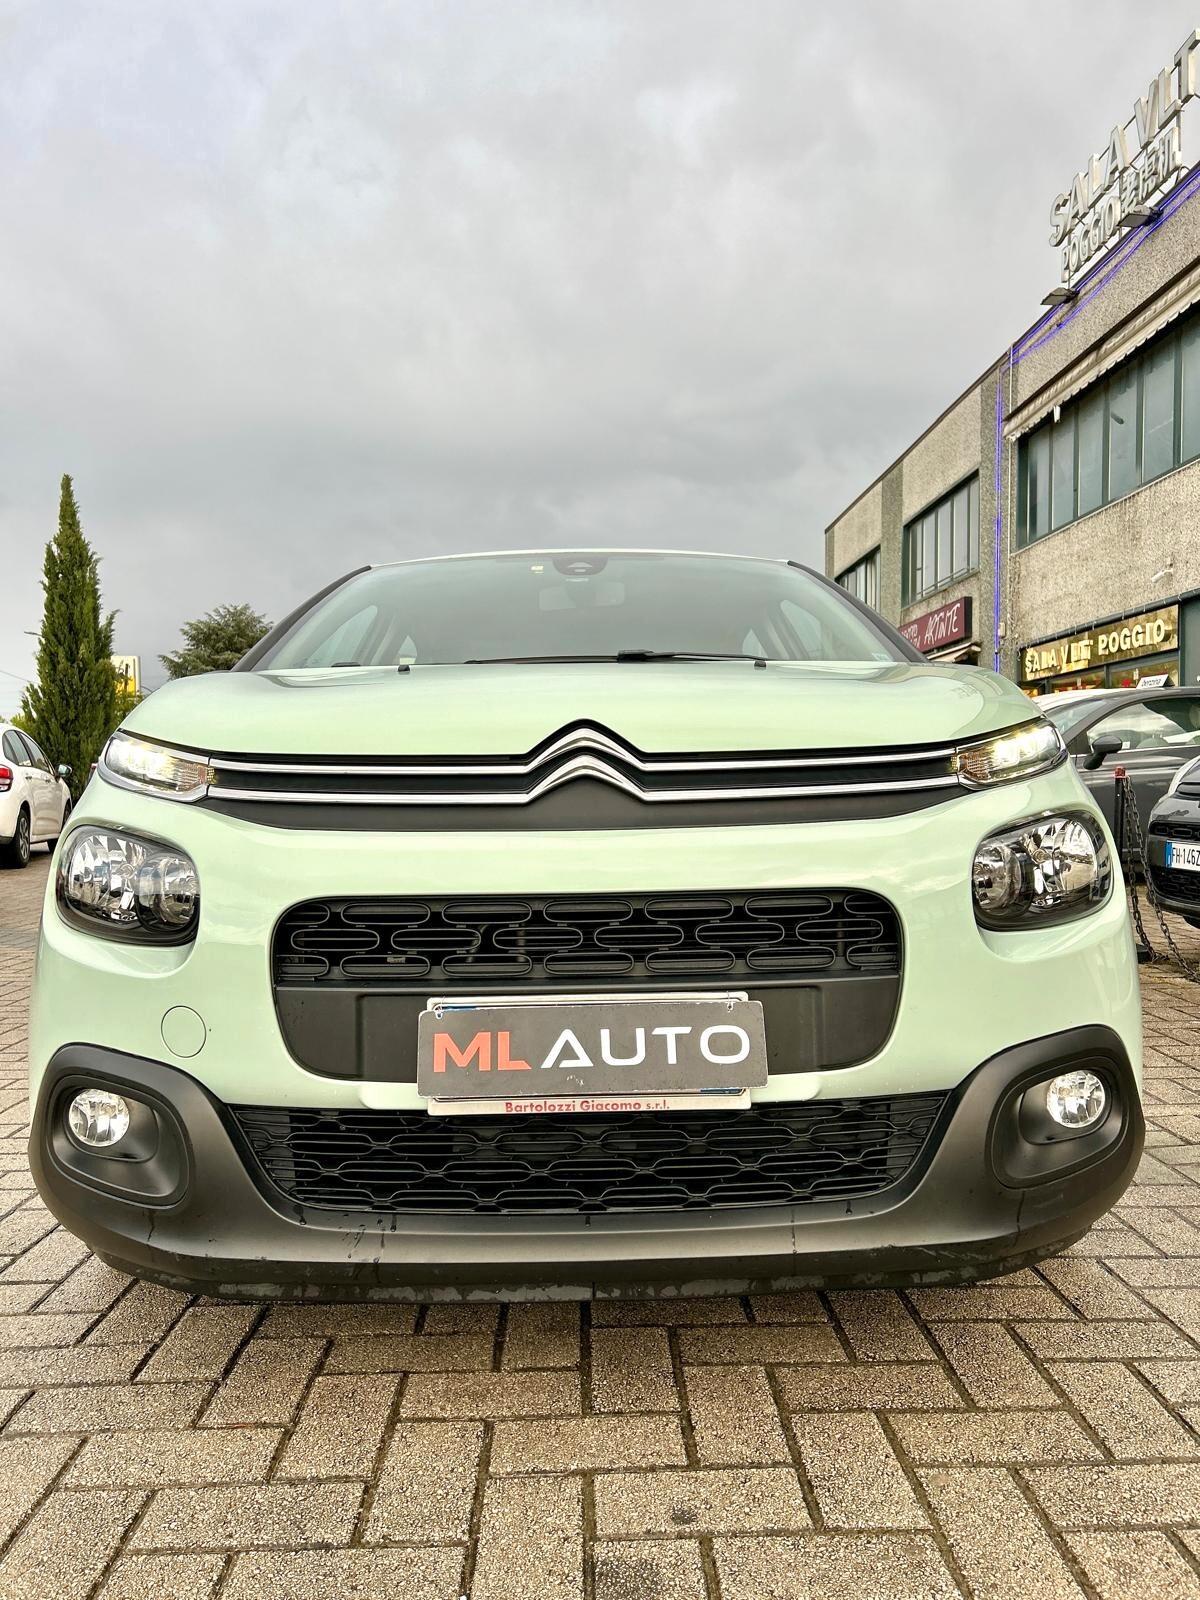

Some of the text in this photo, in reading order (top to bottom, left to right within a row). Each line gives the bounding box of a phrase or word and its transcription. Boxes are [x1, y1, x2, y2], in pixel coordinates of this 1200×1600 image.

[1049, 29, 1200, 247] SALA VLT
[1061, 196, 1120, 283] POGGIO
[1025, 648, 1058, 673] SALA
[1098, 619, 1165, 655] POGGIO
[433, 1025, 750, 1072] ML AUTO
[505, 1100, 670, 1113] Bartolozzi Giacomo s.r.l.
